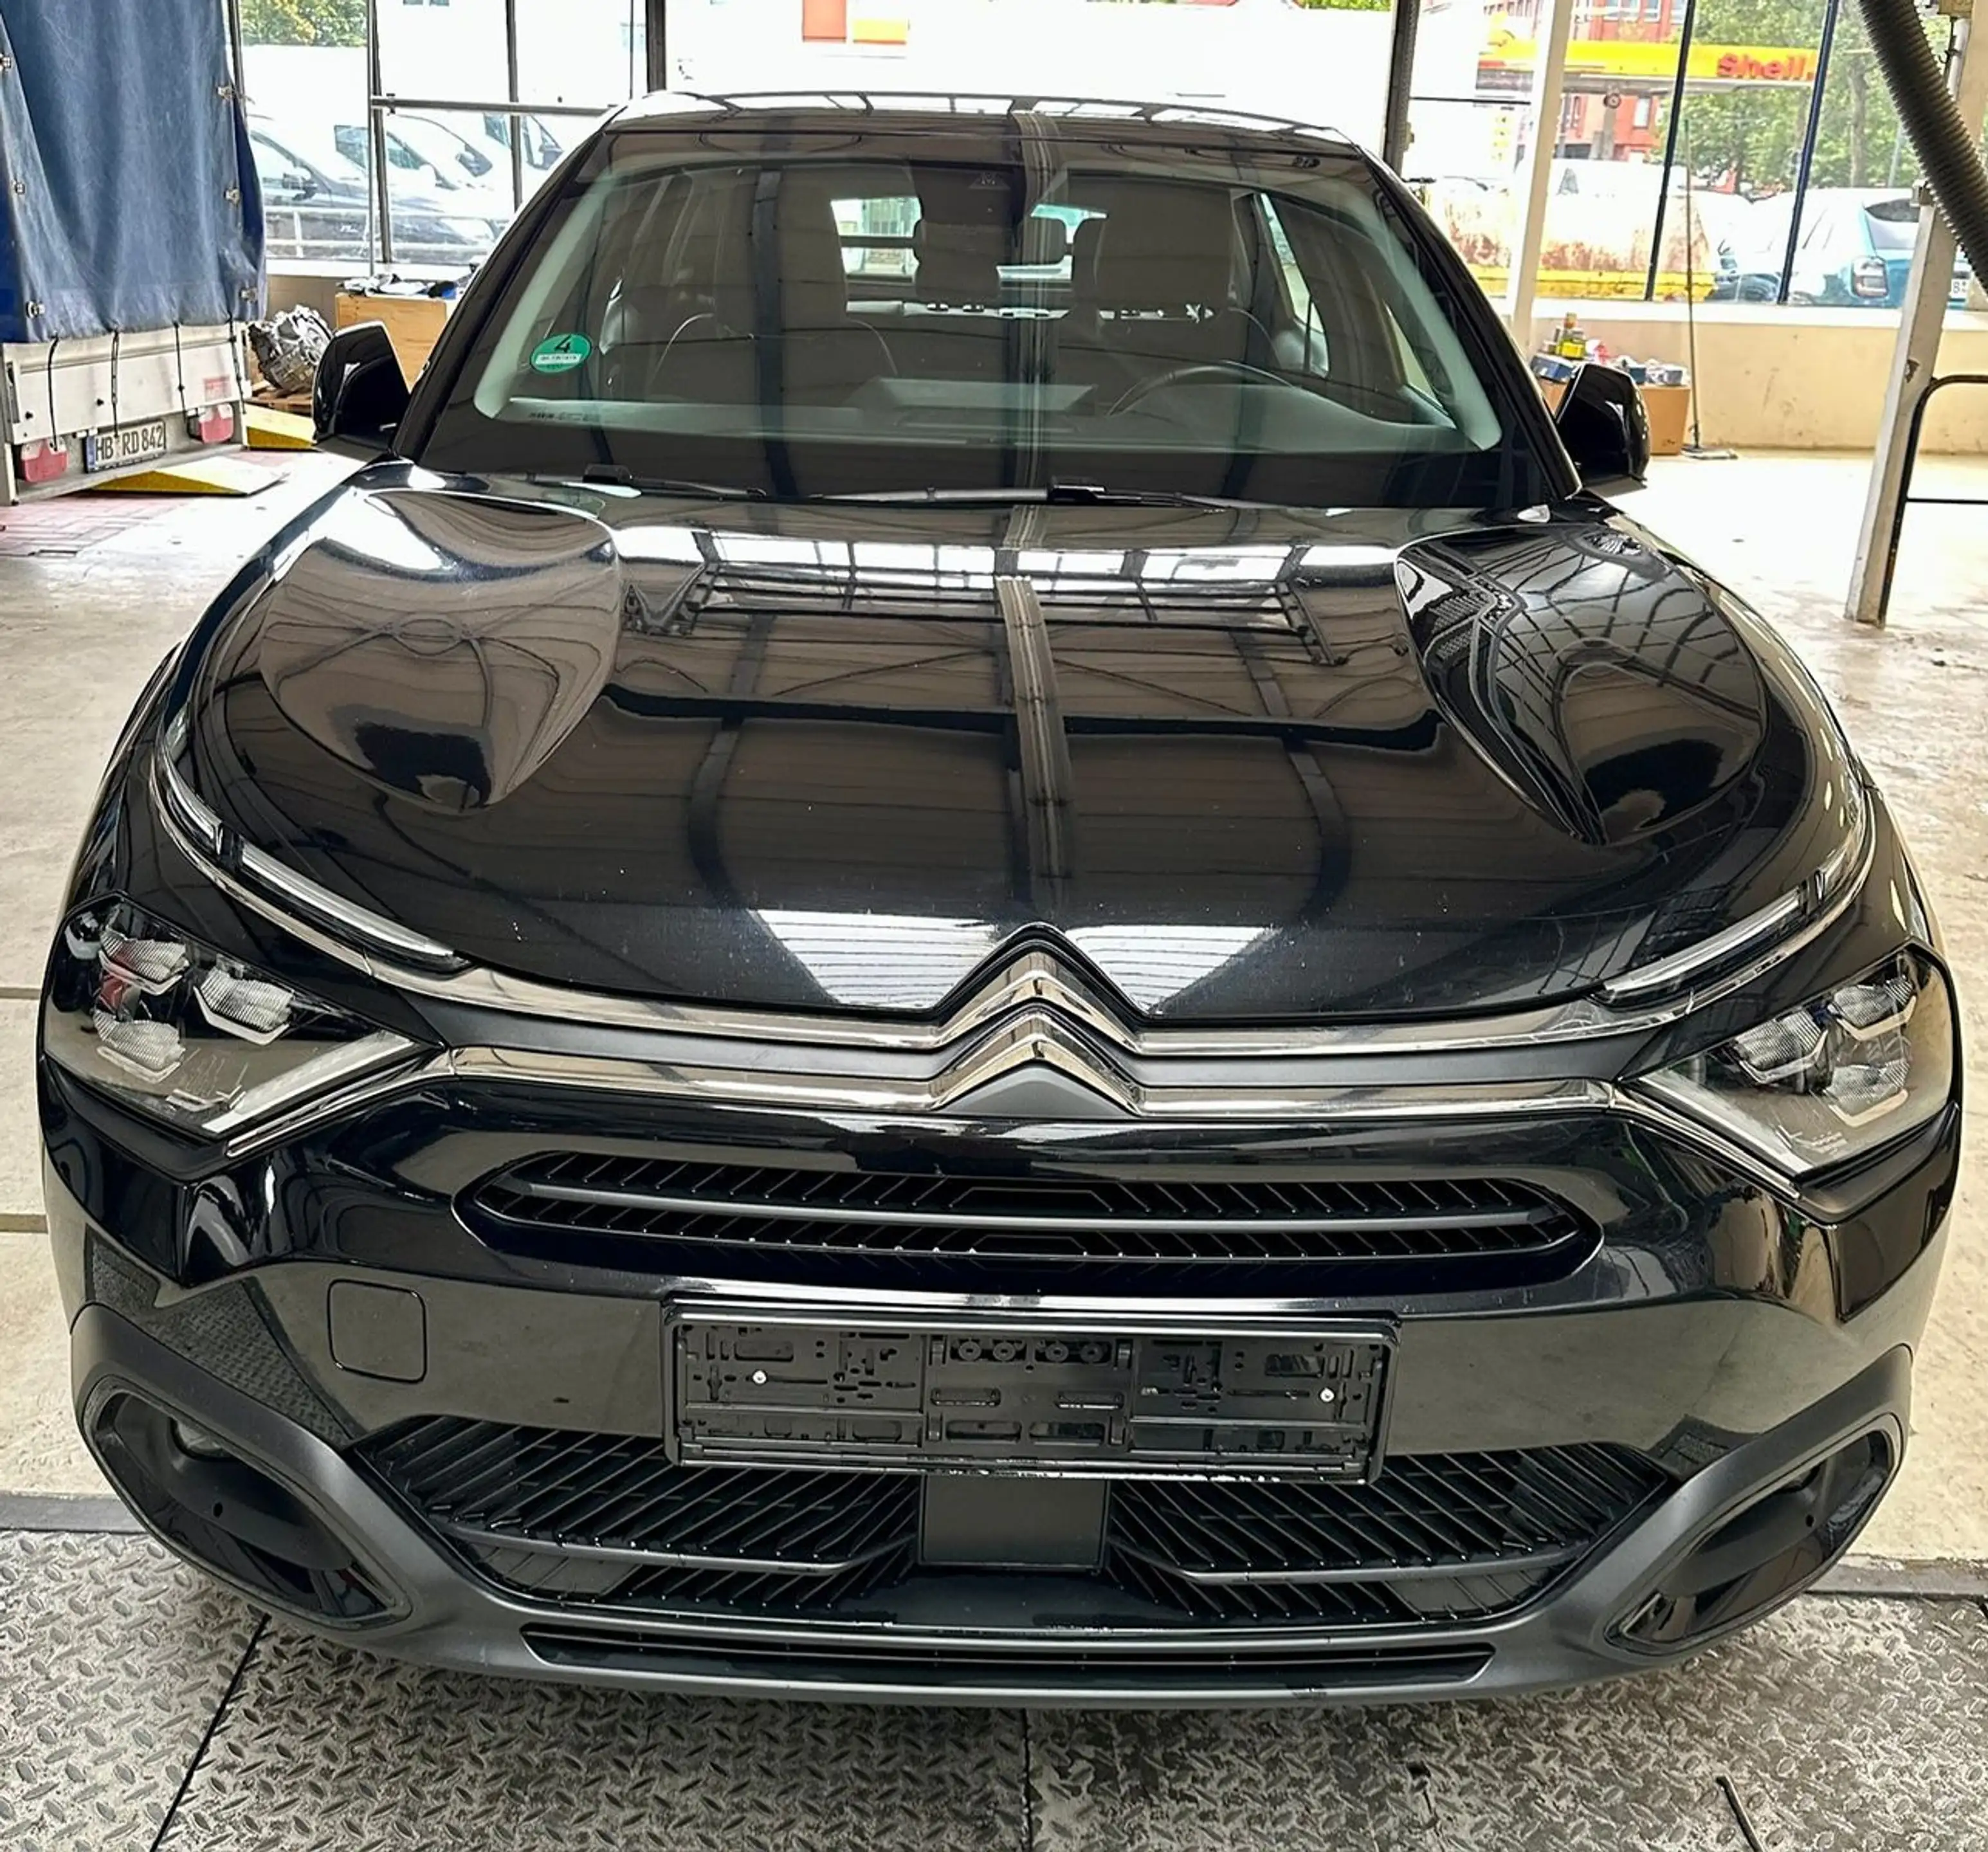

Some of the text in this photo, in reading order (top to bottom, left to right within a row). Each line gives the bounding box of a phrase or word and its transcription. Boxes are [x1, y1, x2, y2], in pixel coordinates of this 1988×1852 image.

[1717, 52, 1806, 80] Shell
[554, 334, 572, 353] 4
[95, 425, 164, 461] HB RD 842
